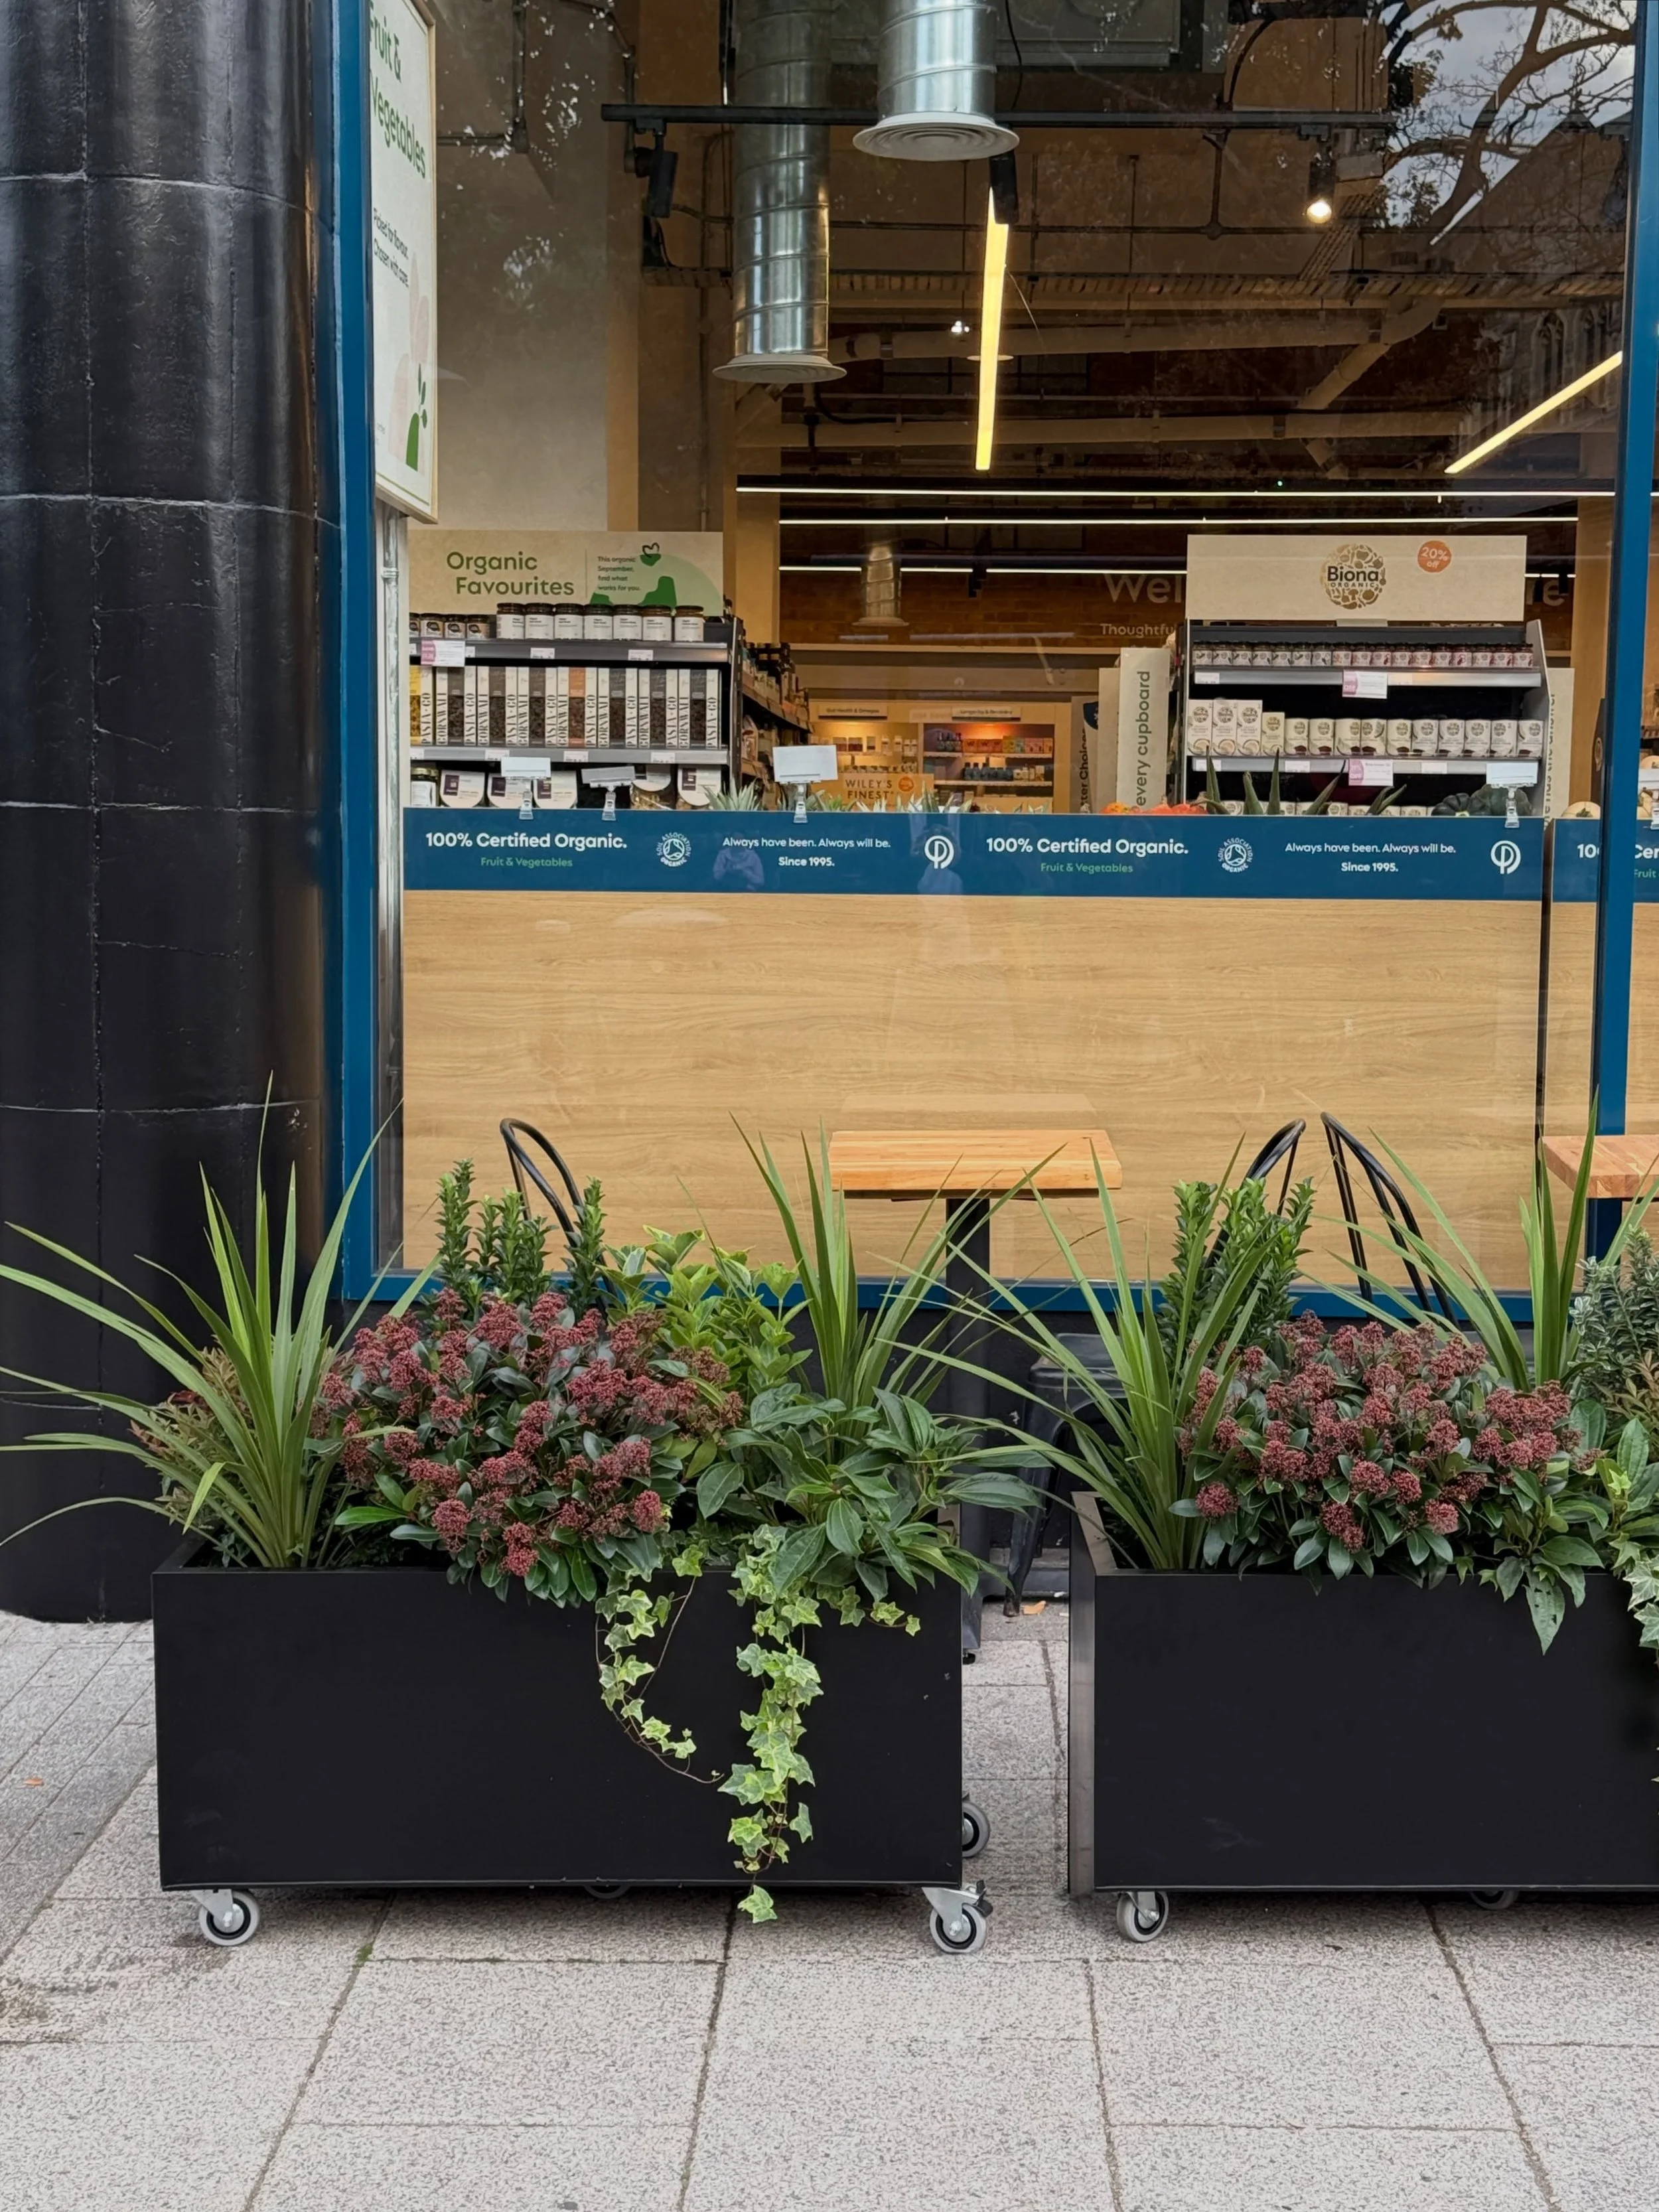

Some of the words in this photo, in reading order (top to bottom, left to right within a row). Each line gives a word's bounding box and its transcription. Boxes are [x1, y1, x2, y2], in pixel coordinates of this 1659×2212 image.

[394, 33, 402, 83] &
[370, 68, 426, 180] Vegetables
[1421, 546, 1449, 561] 20%
[447, 552, 538, 575] Organic
[1427, 560, 1440, 569] off
[1327, 565, 1379, 581] Biona
[456, 577, 575, 595] Favourites
[1104, 573, 1183, 604] Wel
[1136, 671, 1152, 756] cupboard
[845, 779, 893, 789] WILEY'S
[1136, 760, 1151, 806] every
[425, 832, 472, 848] 100%
[476, 832, 551, 848] Certified
[555, 833, 627, 851] Organic.
[723, 838, 759, 848] Always
[762, 838, 786, 848] have
[788, 838, 817, 848] been.
[818, 838, 855, 849] Always
[856, 838, 873, 848] will
[875, 839, 891, 848] be.
[986, 838, 1033, 853] 100%
[1037, 838, 1112, 853] Certified
[1115, 839, 1189, 857] Organic.
[1285, 843, 1322, 853] Always
[1324, 843, 1350, 853] have
[1352, 844, 1380, 853] been.
[1382, 844, 1419, 854] Always
[1421, 844, 1438, 853] will
[1440, 844, 1456, 853] be.
[1224, 838, 1253, 863] ASSOCIATION
[1577, 844, 1600, 858] 10
[481, 857, 504, 867] Fruit
[506, 857, 514, 867] &
[516, 857, 573, 868] Vegetables
[778, 856, 807, 866] Since
[809, 857, 835, 866] 1995.
[1041, 863, 1064, 872] Fruit
[1066, 863, 1074, 873] &
[1075, 863, 1133, 874] Vegetables
[1341, 861, 1370, 871] Since
[1372, 862, 1398, 872] 1995.
